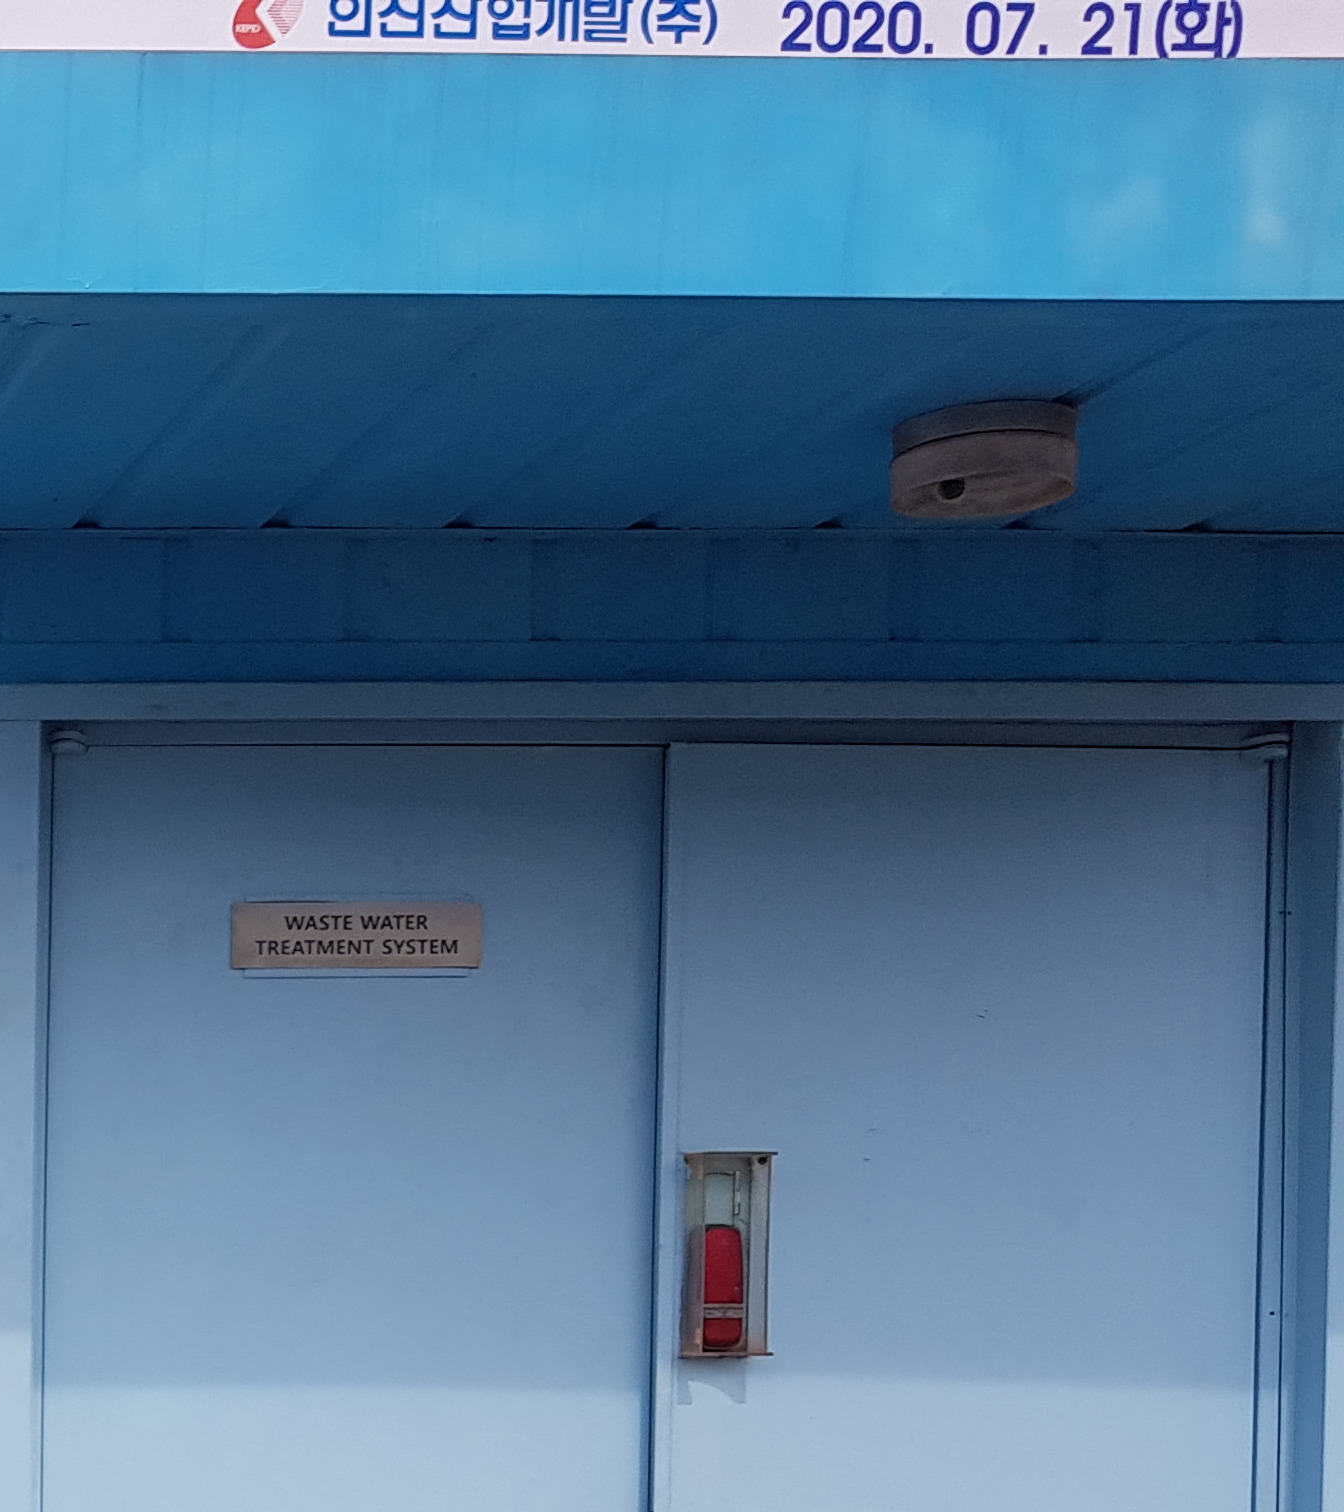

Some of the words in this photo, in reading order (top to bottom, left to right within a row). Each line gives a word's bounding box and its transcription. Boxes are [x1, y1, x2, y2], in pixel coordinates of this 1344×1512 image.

[780, 1, 934, 54] 2020.
[965, 2, 1049, 56] 07.
[1081, 0, 1244, 59] 21(화)
[283, 915, 353, 931] WASTE
[360, 914, 429, 931] WATER
[255, 939, 375, 956] TREATMENT
[382, 939, 459, 955] SYSTEM
